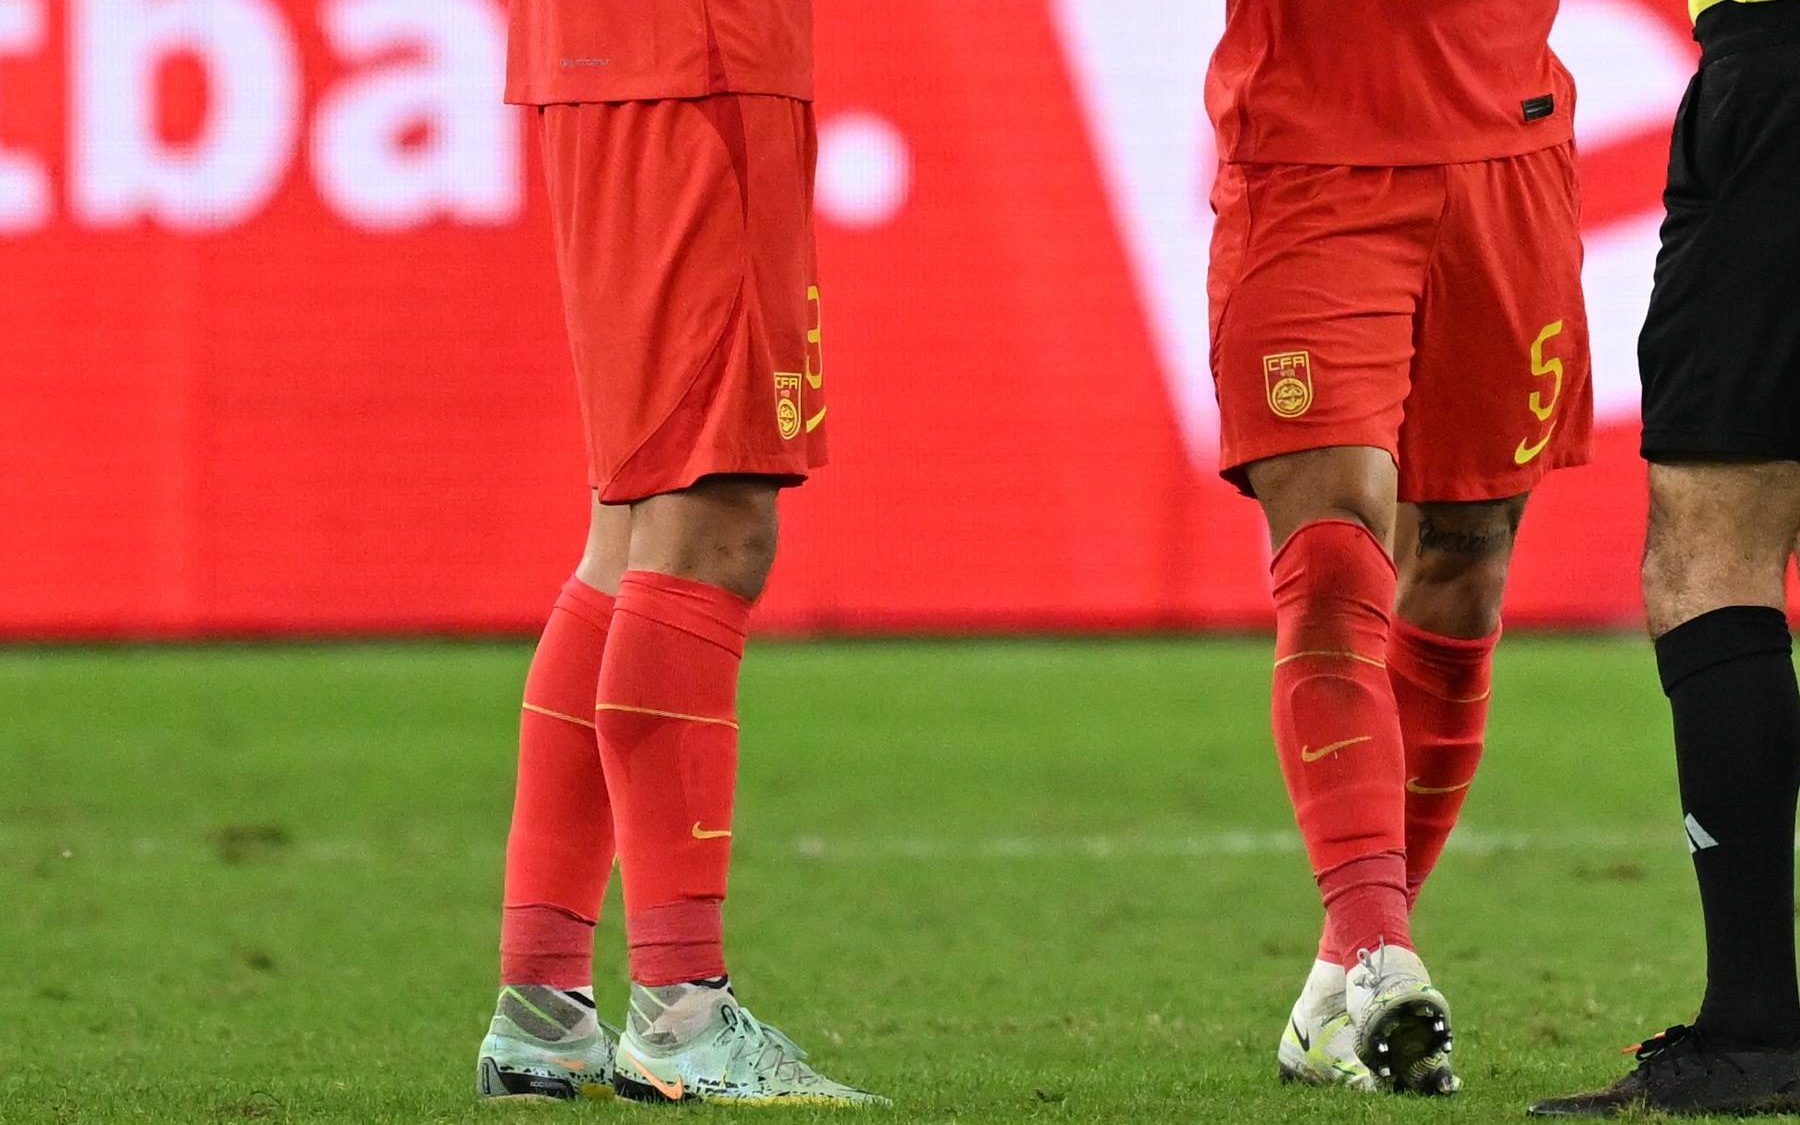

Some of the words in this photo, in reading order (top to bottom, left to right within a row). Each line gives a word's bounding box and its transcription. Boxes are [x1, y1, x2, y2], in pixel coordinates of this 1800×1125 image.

[805, 285, 823, 389] 3
[1268, 355, 1305, 371] CFA
[775, 377, 798, 390] CFA
[1529, 320, 1563, 421] 5
